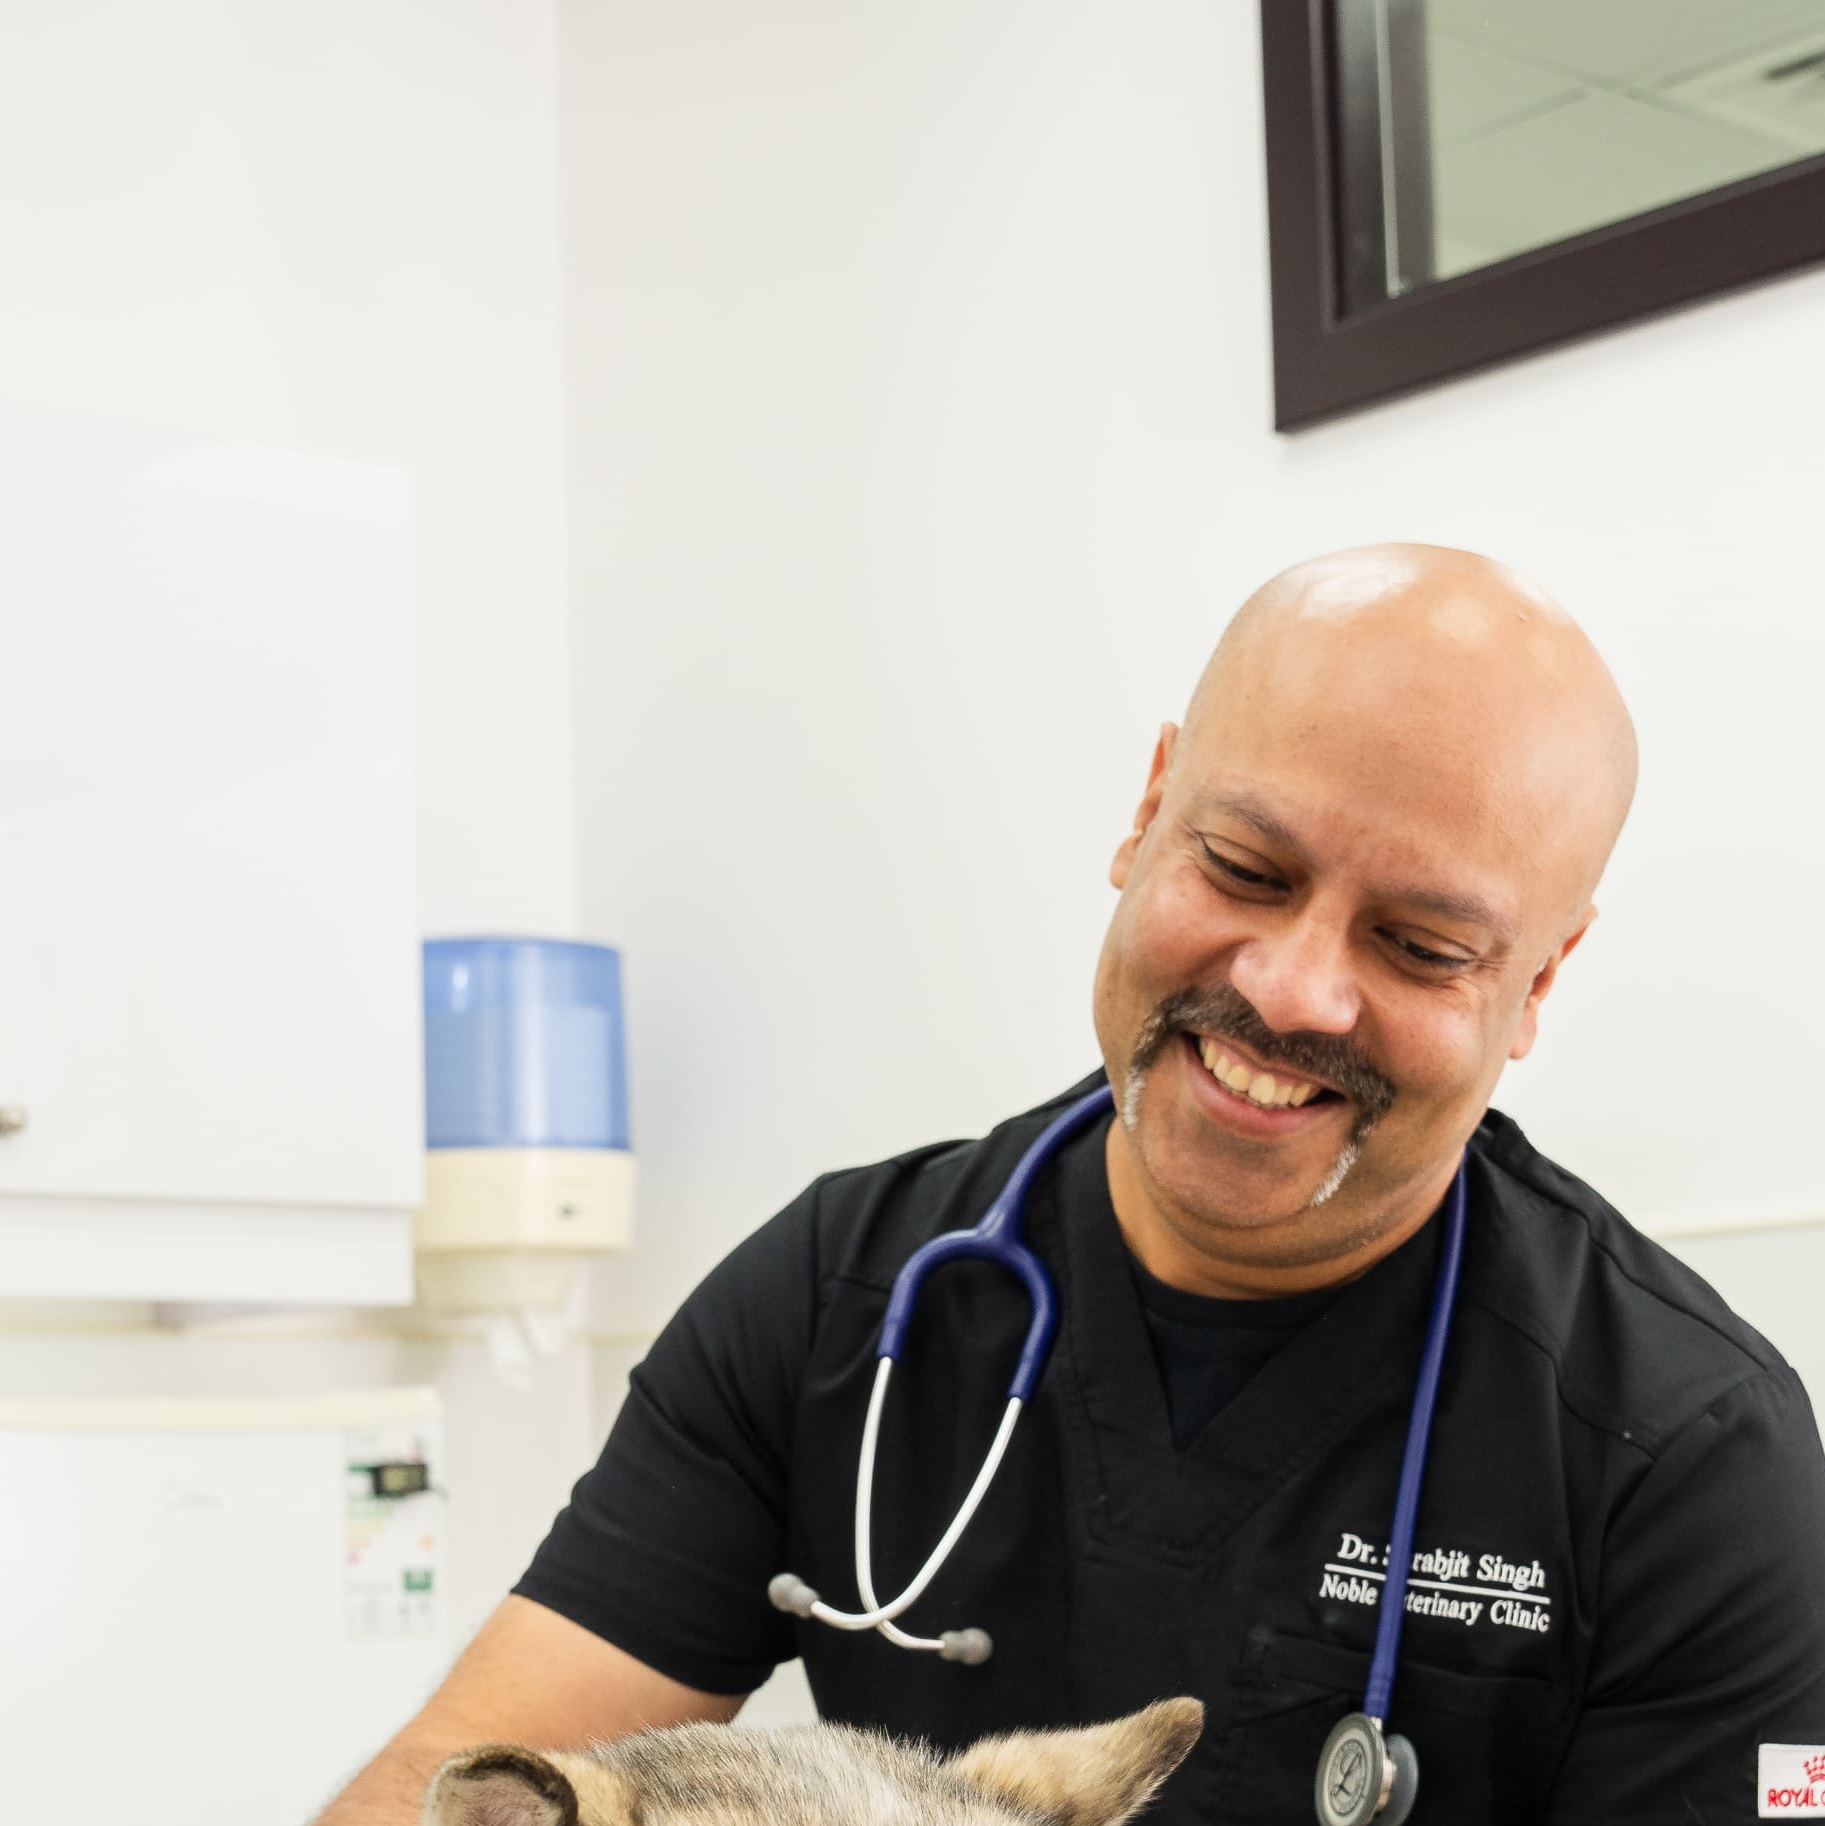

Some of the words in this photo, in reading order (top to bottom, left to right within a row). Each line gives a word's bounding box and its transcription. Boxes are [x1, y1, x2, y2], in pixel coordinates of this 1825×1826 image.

[1337, 1533, 1378, 1564] Dr.
[1382, 1544, 1471, 1582] rabjit
[1476, 1553, 1546, 1591] Singh
[1319, 1573, 1378, 1606] Noble
[1403, 1590, 1484, 1627] terinary
[1490, 1599, 1551, 1633] Clinic
[1767, 1785, 1819, 1808] ROYAL
